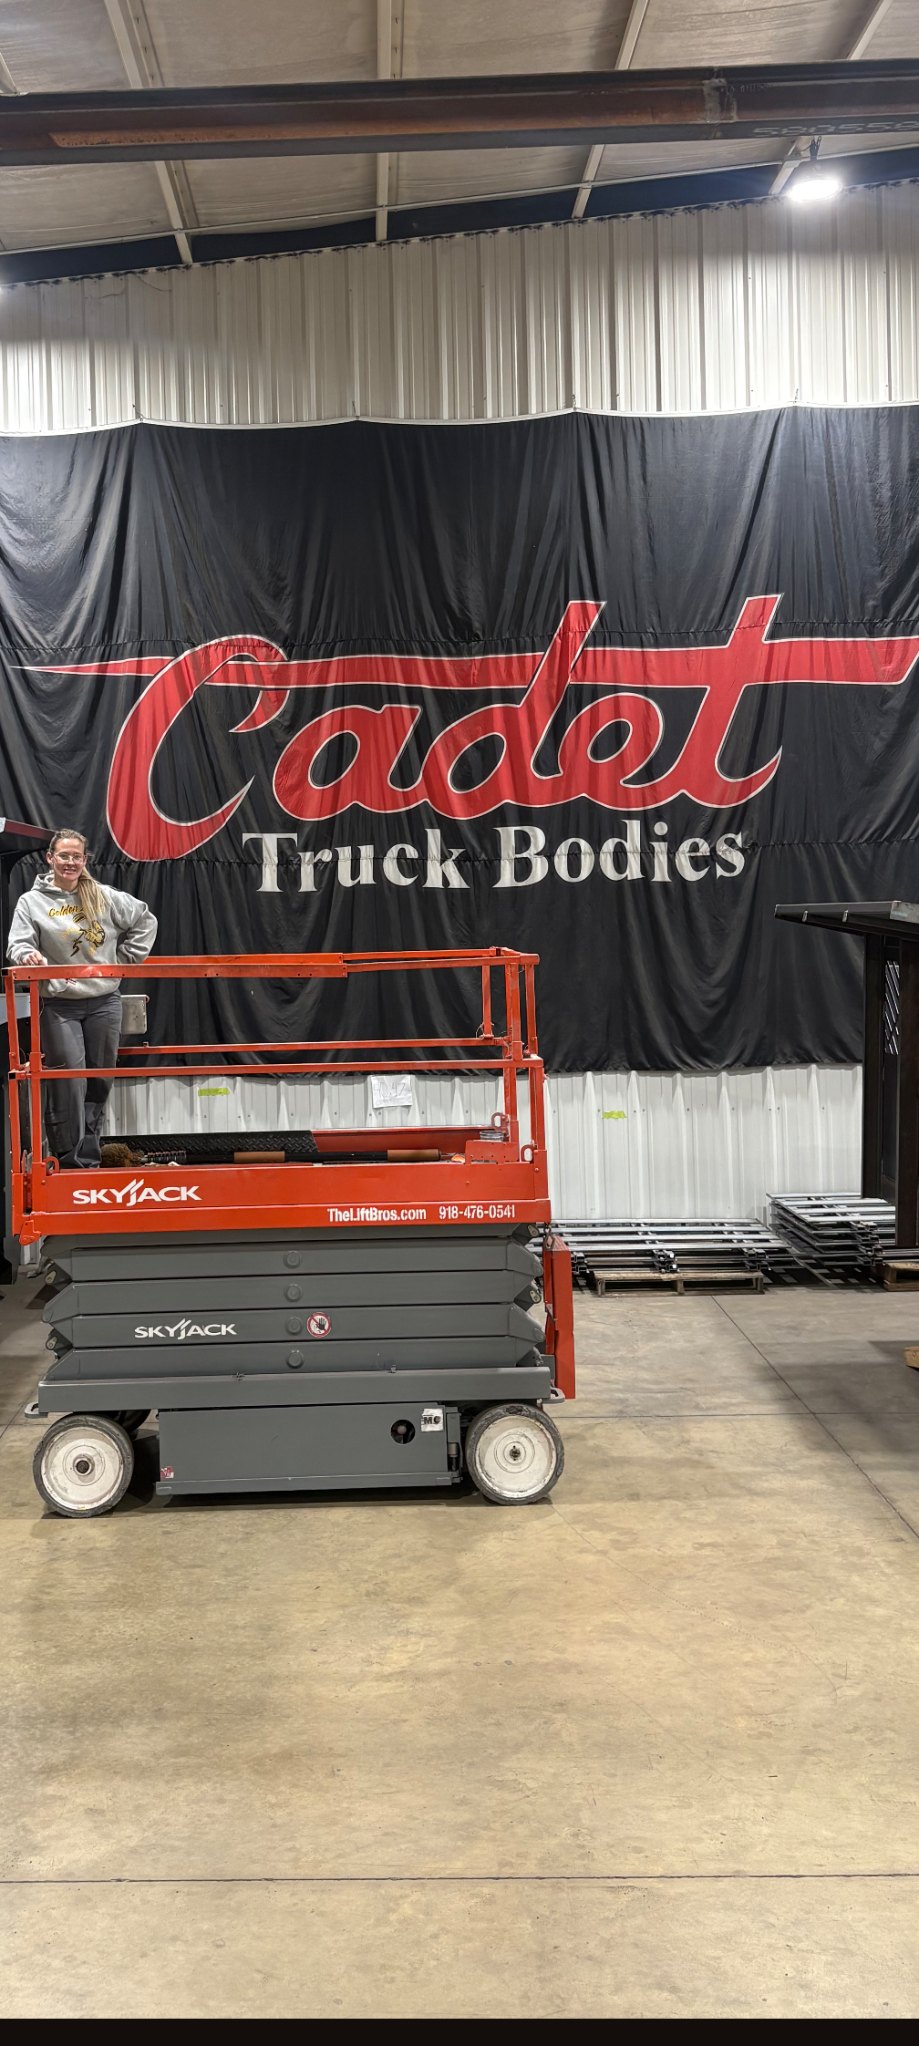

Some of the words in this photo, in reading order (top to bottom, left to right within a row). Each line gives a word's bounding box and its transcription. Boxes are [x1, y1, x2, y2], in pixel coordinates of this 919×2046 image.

[12, 593, 919, 862] Cadet
[242, 828, 471, 892] Truck
[492, 820, 746, 889] Bodies
[72, 1179, 203, 1207] SKYJACK
[327, 1207, 427, 1222] TheLiftBros.com
[438, 1204, 516, 1219] 918-476-0541
[134, 1318, 238, 1340] SKYJACK
